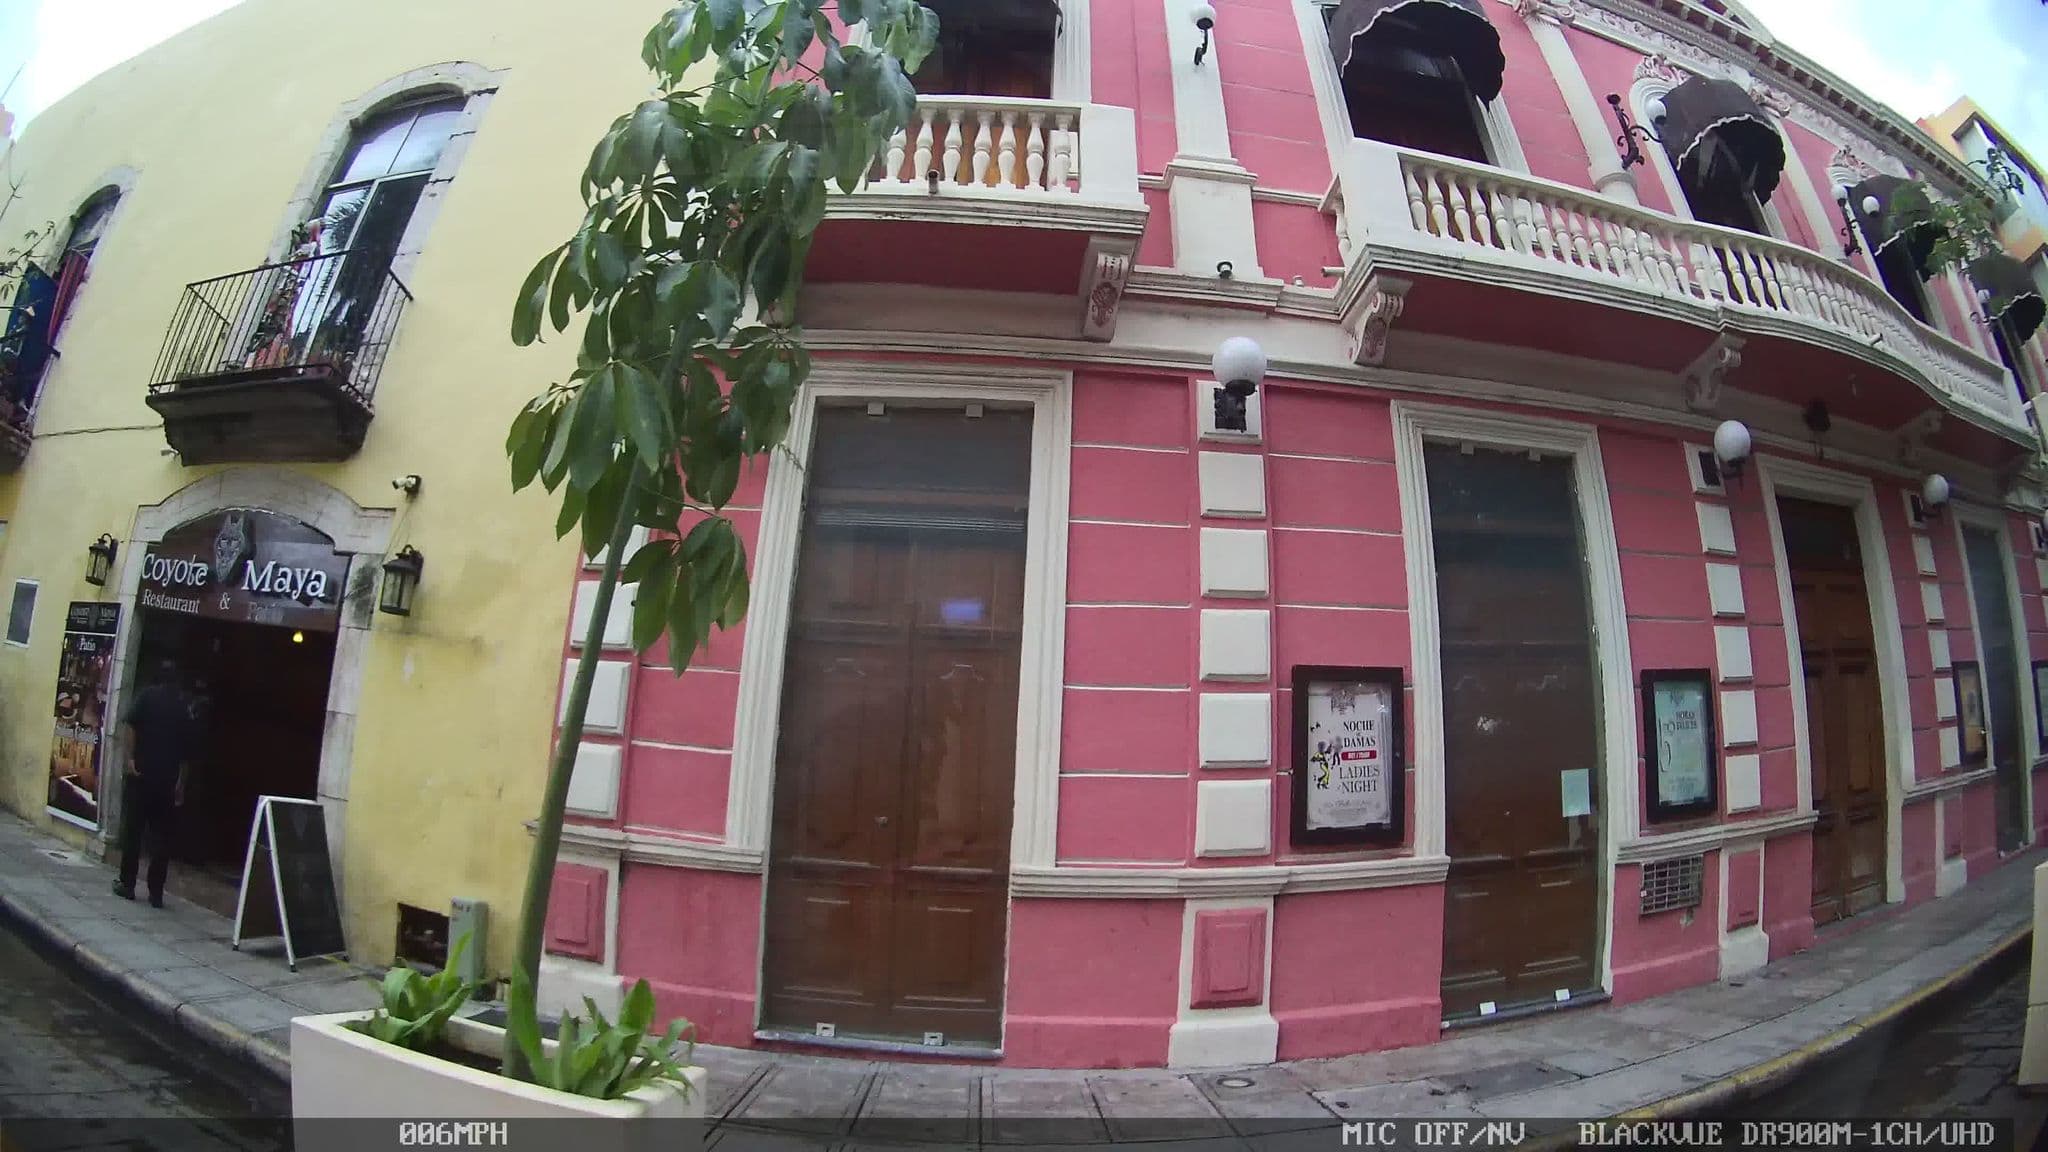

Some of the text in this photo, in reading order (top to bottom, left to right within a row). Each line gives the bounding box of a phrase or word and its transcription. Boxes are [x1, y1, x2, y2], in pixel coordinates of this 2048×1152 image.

[141, 553, 327, 599] Coyote Maya
[142, 589, 200, 614] Restaurant
[219, 592, 231, 609] &
[1343, 720, 1375, 732] NOCHE
[1343, 737, 1376, 748] DAMAS
[1340, 765, 1380, 779] LADIES
[1341, 780, 1377, 793] NIGHT
